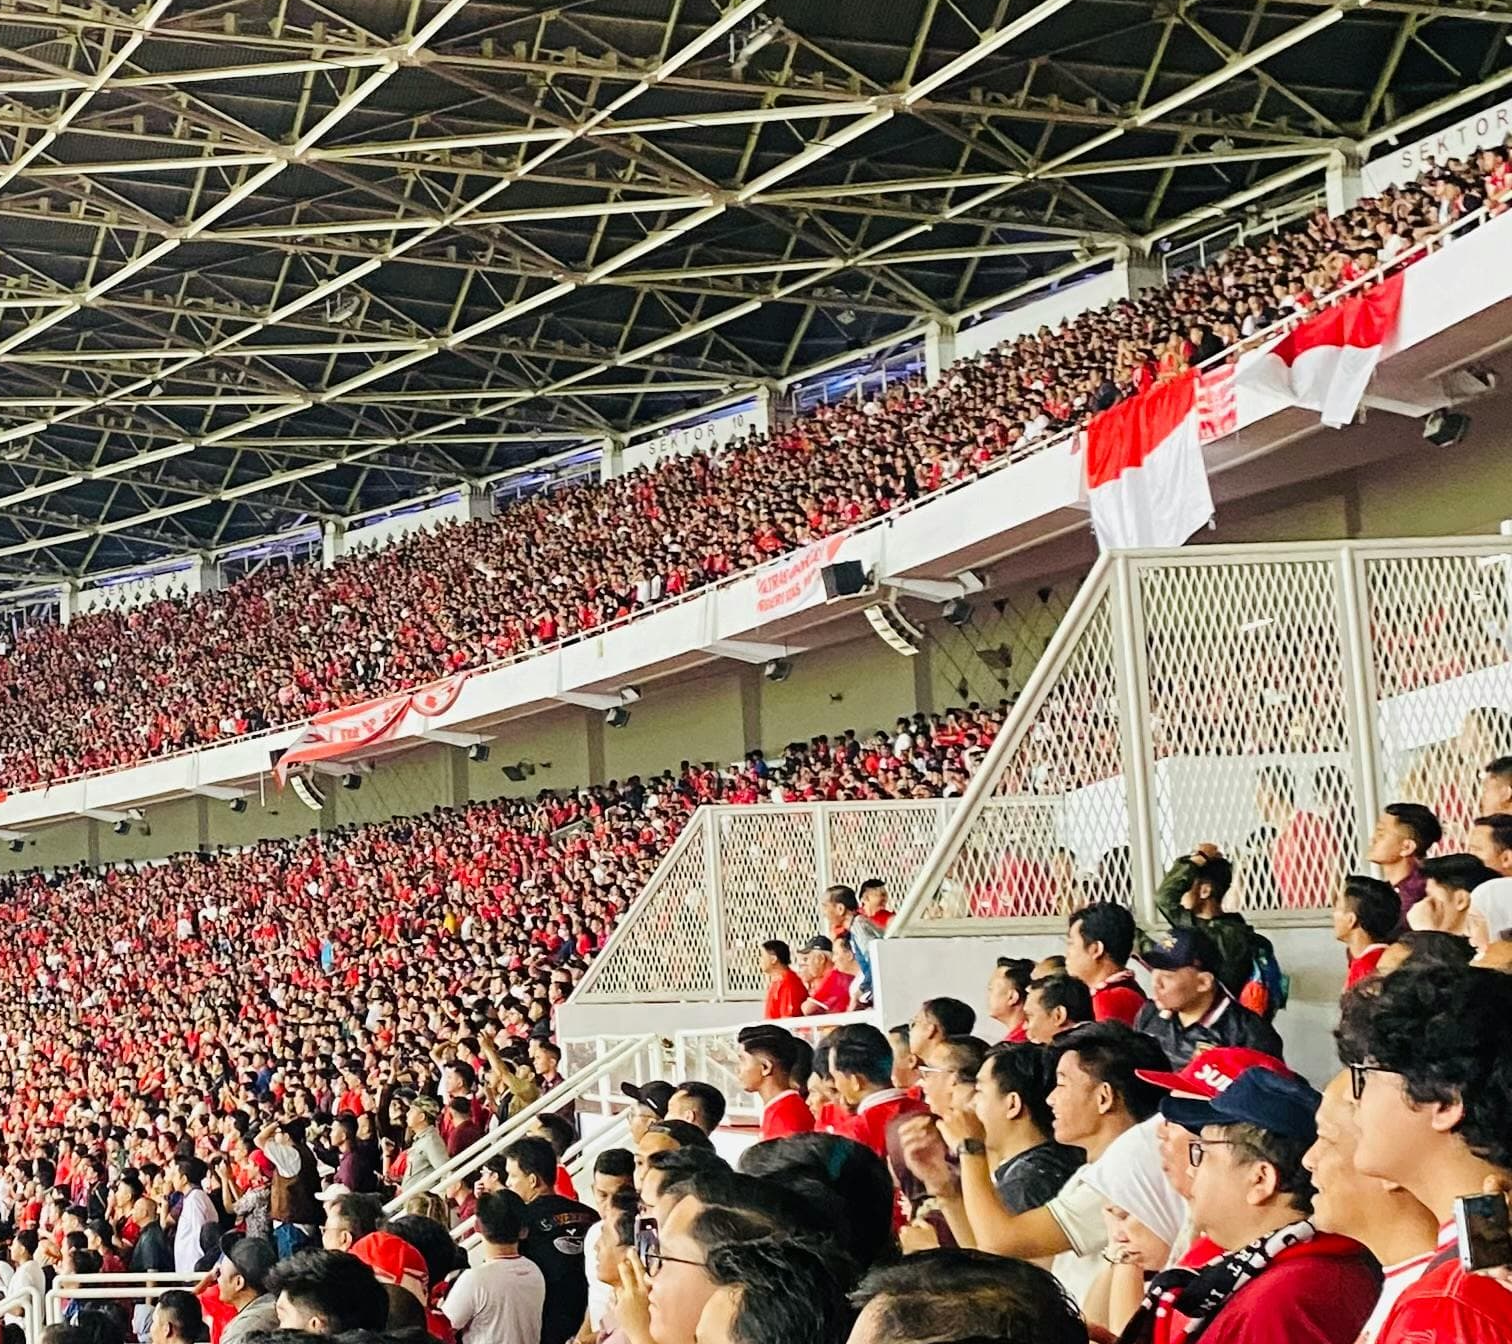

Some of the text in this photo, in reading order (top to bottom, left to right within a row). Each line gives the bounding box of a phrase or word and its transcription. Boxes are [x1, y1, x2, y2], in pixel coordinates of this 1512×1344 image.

[1400, 109, 1509, 168] SEKTOR
[648, 414, 744, 455] SEKTOR 10
